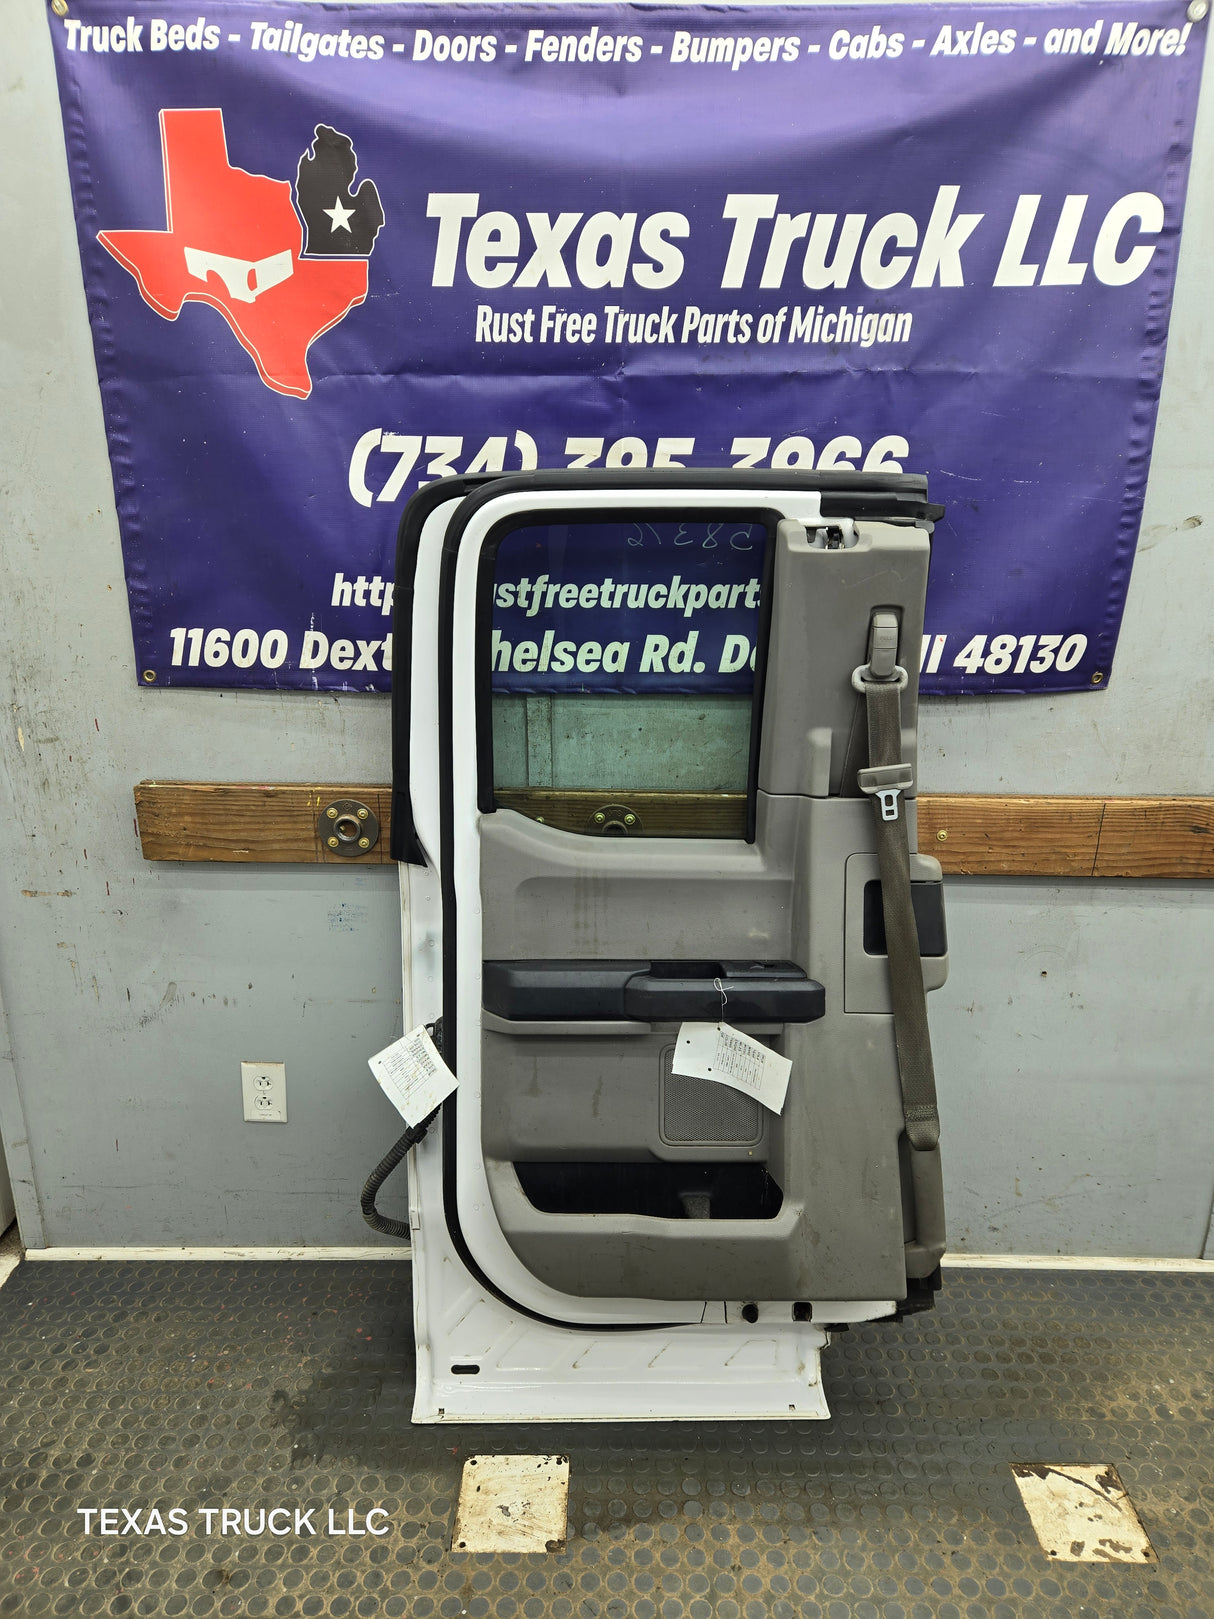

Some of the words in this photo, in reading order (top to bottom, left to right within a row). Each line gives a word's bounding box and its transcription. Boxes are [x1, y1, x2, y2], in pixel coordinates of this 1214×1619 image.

[64, 17, 144, 53] Truck
[151, 17, 221, 51] Beds
[250, 20, 385, 62] Tailgates
[413, 29, 498, 62] Doors
[525, 27, 644, 63] Fenders
[670, 31, 801, 71] Bumpers
[828, 26, 906, 61] Cabs
[929, 22, 1018, 57] Axles
[1044, 20, 1105, 54] and
[1103, 22, 1193, 57] More!
[427, 193, 690, 290] Texas
[720, 185, 985, 290] Truck
[993, 191, 1165, 287] LLC
[475, 305, 536, 344] Rust
[539, 305, 597, 344] Free
[604, 305, 679, 344] Truck
[681, 306, 754, 344] Parts
[757, 306, 788, 344] of
[788, 305, 913, 348] Michigan
[493, 574, 761, 618] stfreetruckpart
[169, 627, 289, 669] 11600
[299, 628, 393, 672] Dext
[491, 629, 631, 673] helsea
[638, 630, 706, 674] Rd.
[952, 634, 1088, 674] 48130
